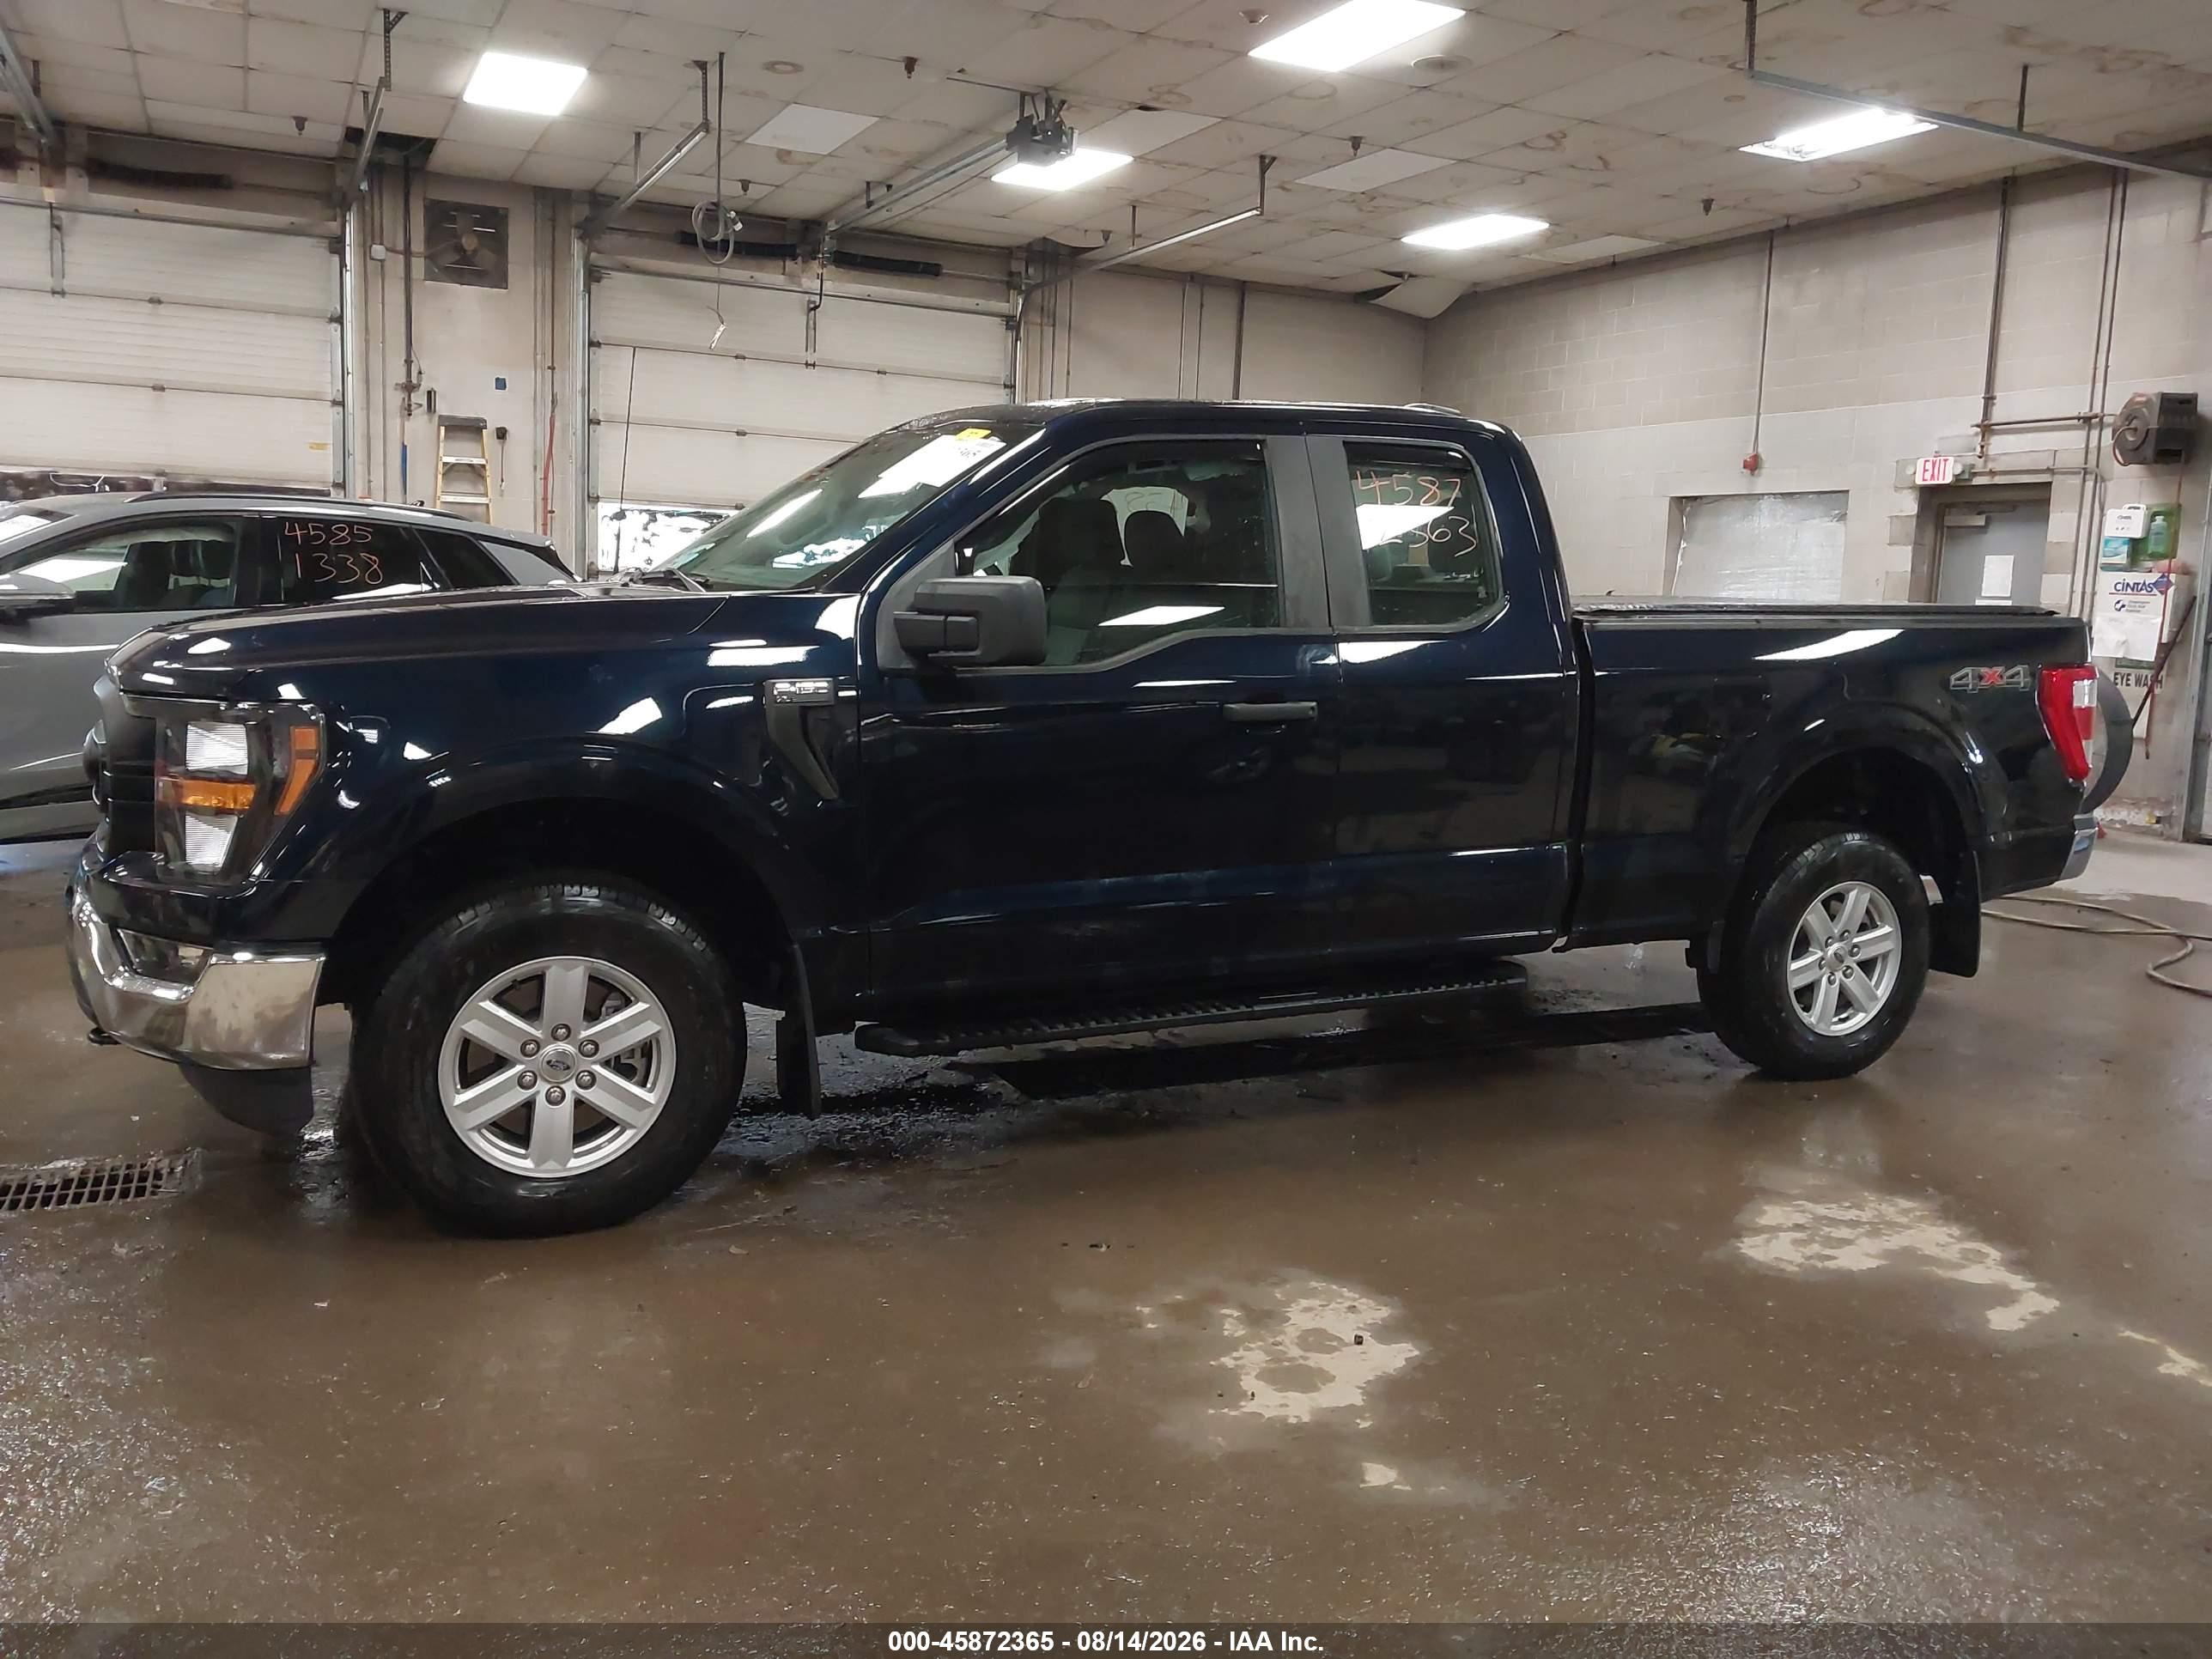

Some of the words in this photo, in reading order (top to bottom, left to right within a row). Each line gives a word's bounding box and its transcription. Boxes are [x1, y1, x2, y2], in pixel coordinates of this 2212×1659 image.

[1923, 459, 1949, 482] EXIT
[1356, 470, 1462, 507] 4587
[284, 521, 374, 546] 4585
[295, 551, 384, 586] 1338
[2113, 672, 2130, 687] EYE
